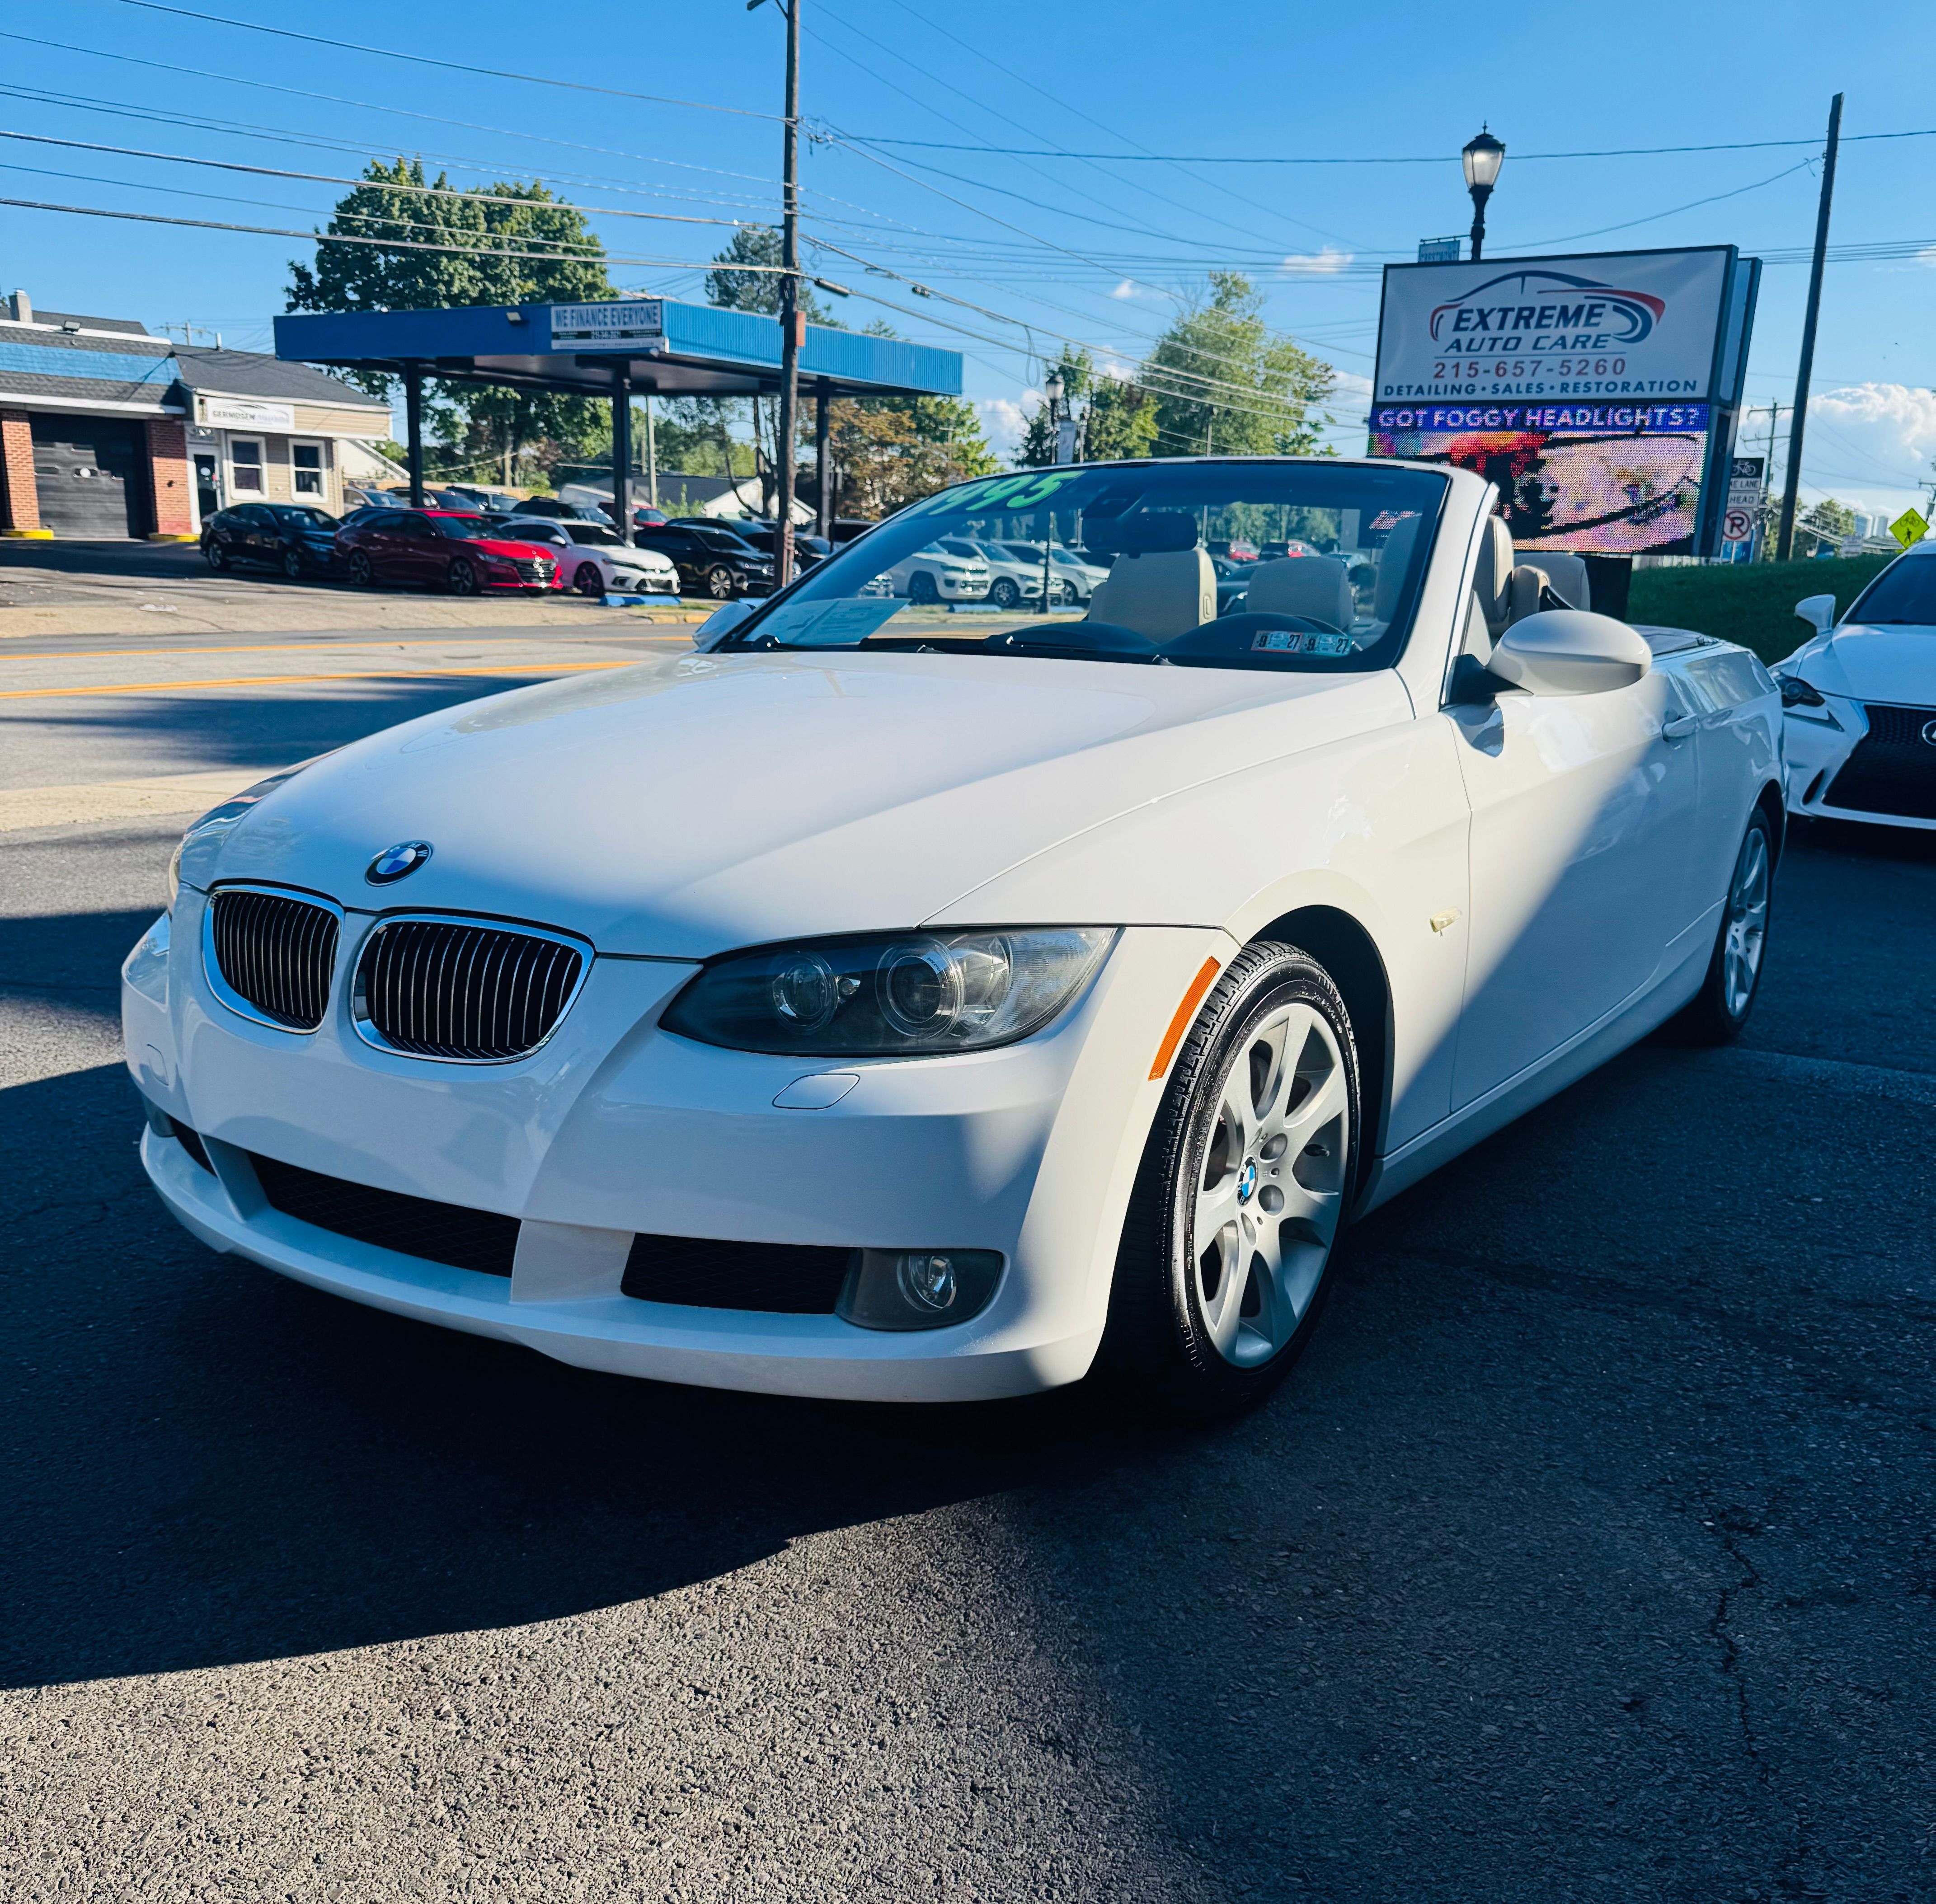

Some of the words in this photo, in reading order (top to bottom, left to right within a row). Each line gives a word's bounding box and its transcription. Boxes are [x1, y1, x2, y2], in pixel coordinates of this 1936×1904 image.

[555, 309, 568, 327] WE
[571, 307, 607, 327] FINANCE
[611, 305, 658, 326] EVERYONE
[1452, 303, 1606, 332] EXTREME
[1444, 337, 1522, 353] AUTO
[1532, 334, 1612, 351] CARE
[1433, 358, 1626, 379] 215-657-5260
[1384, 384, 1477, 396] DETAILING
[1491, 382, 1544, 394] SALES
[1560, 380, 1697, 394] RESTORATION
[1378, 408, 1427, 427] GOT
[1433, 408, 1519, 427] FOGGY
[1526, 407, 1699, 426] HEADLIGHTS?
[1740, 480, 1758, 488] LANE
[1287, 634, 1301, 649] 27
[1335, 638, 1349, 654] 27
